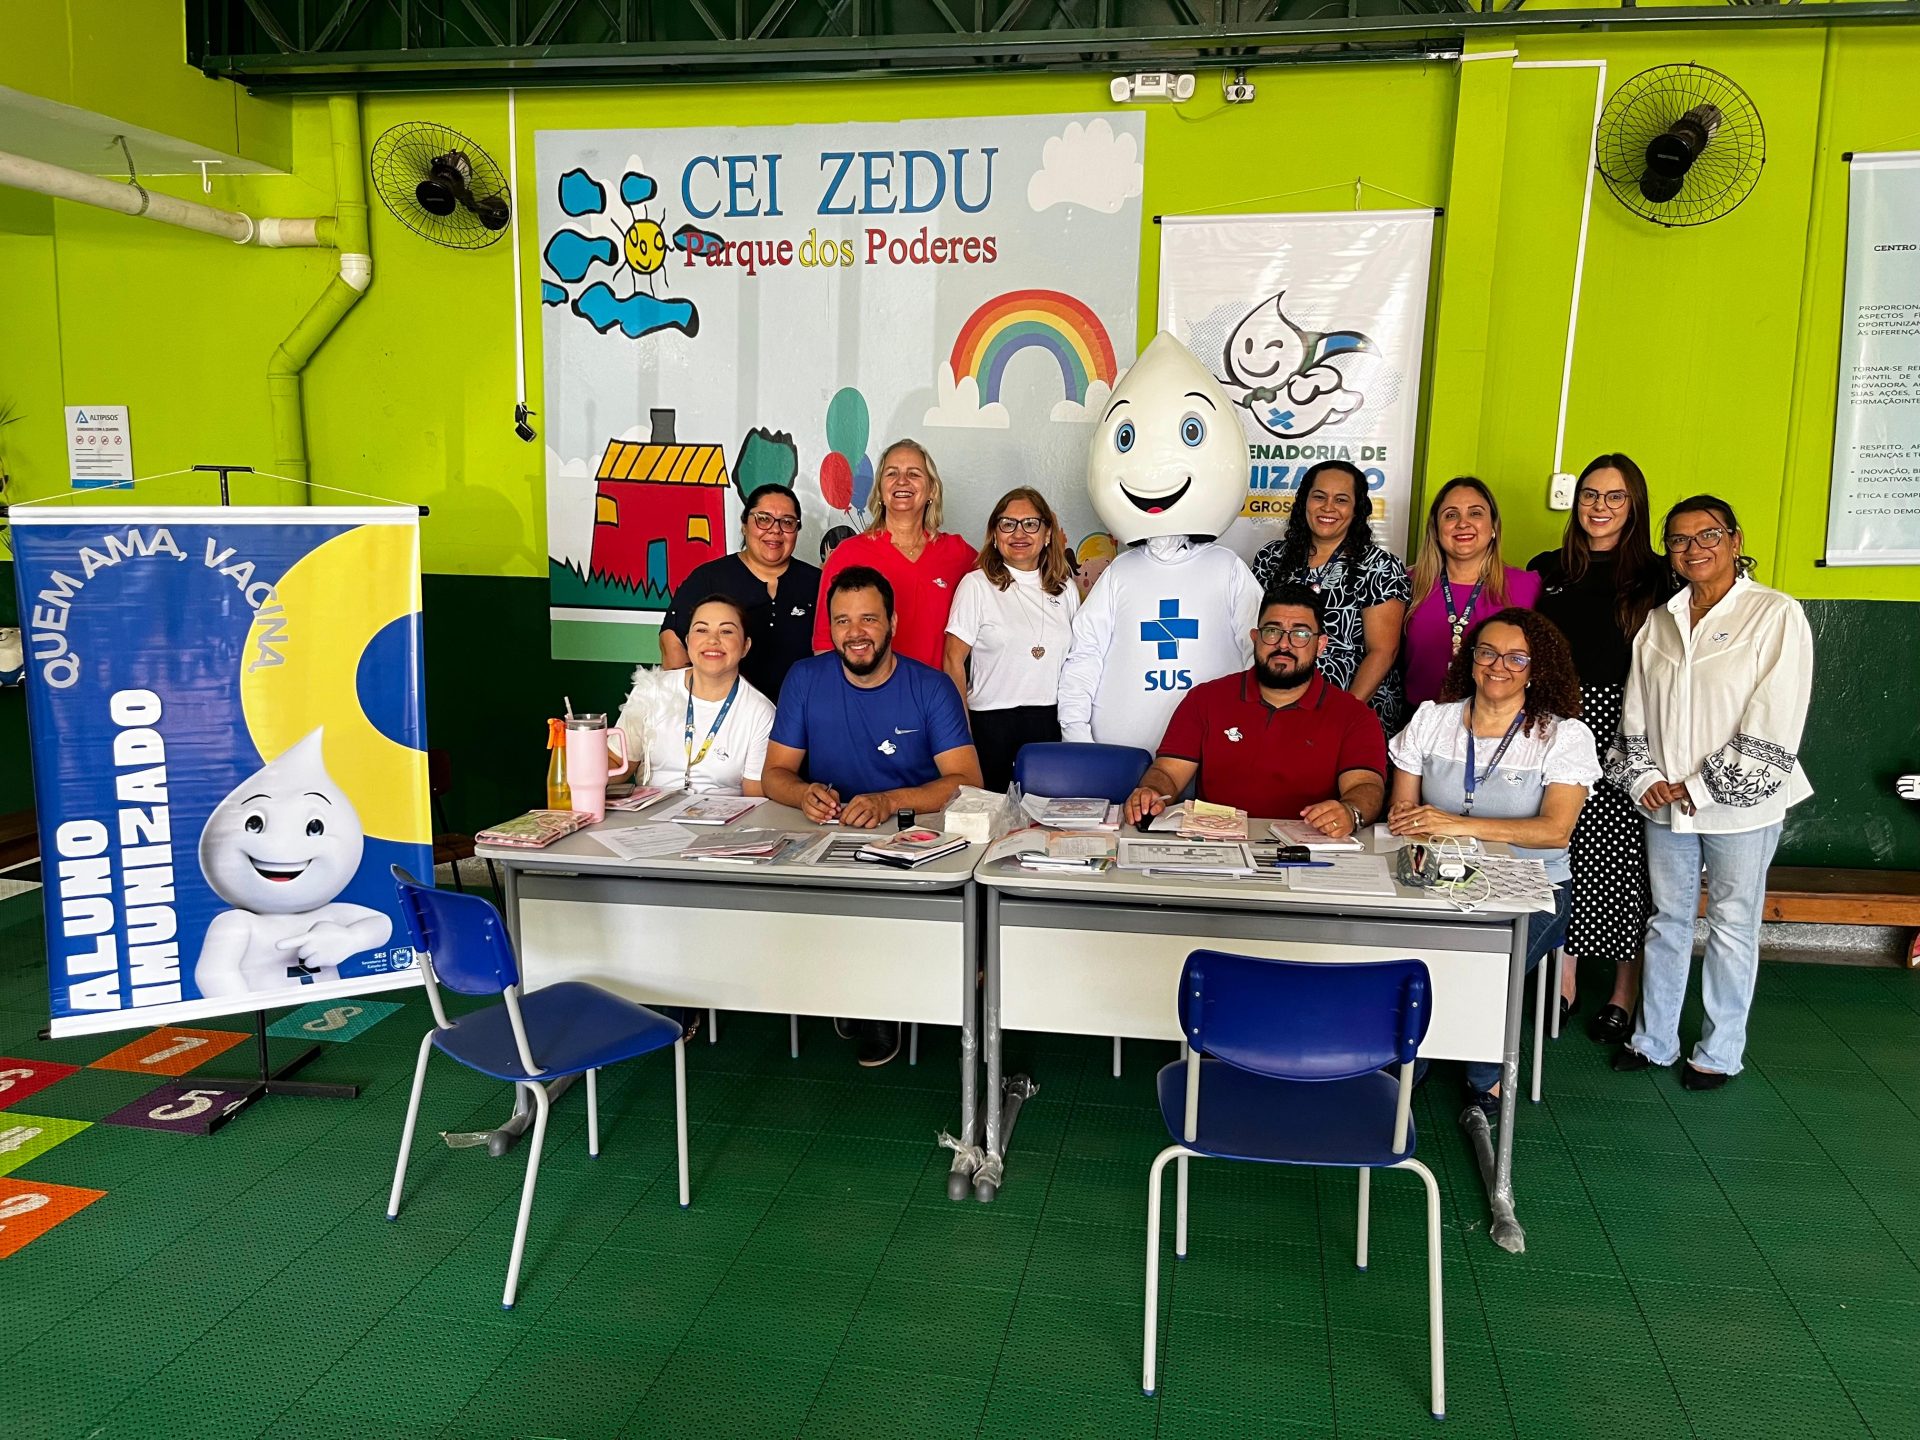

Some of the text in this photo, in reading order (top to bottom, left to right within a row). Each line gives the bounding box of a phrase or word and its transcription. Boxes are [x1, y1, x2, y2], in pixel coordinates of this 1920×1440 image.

[681, 147, 1000, 220] CEI ZEDU
[683, 227, 998, 276] Parque dos Poderes
[1874, 244, 1917, 252] CENTRO
[1858, 312, 1904, 320] ASPECTOS
[1850, 390, 1874, 398] SUAS
[1878, 389, 1910, 397] AÇÕES,
[1248, 444, 1387, 461] ENADORIA DE
[32, 569, 87, 690] QUEM
[78, 527, 189, 580] AMA,
[1144, 669, 1193, 691] SUS
[108, 688, 183, 1008] IMUNIZADO
[56, 819, 123, 1010] ALUNO
[148, 1089, 227, 1121] 5
